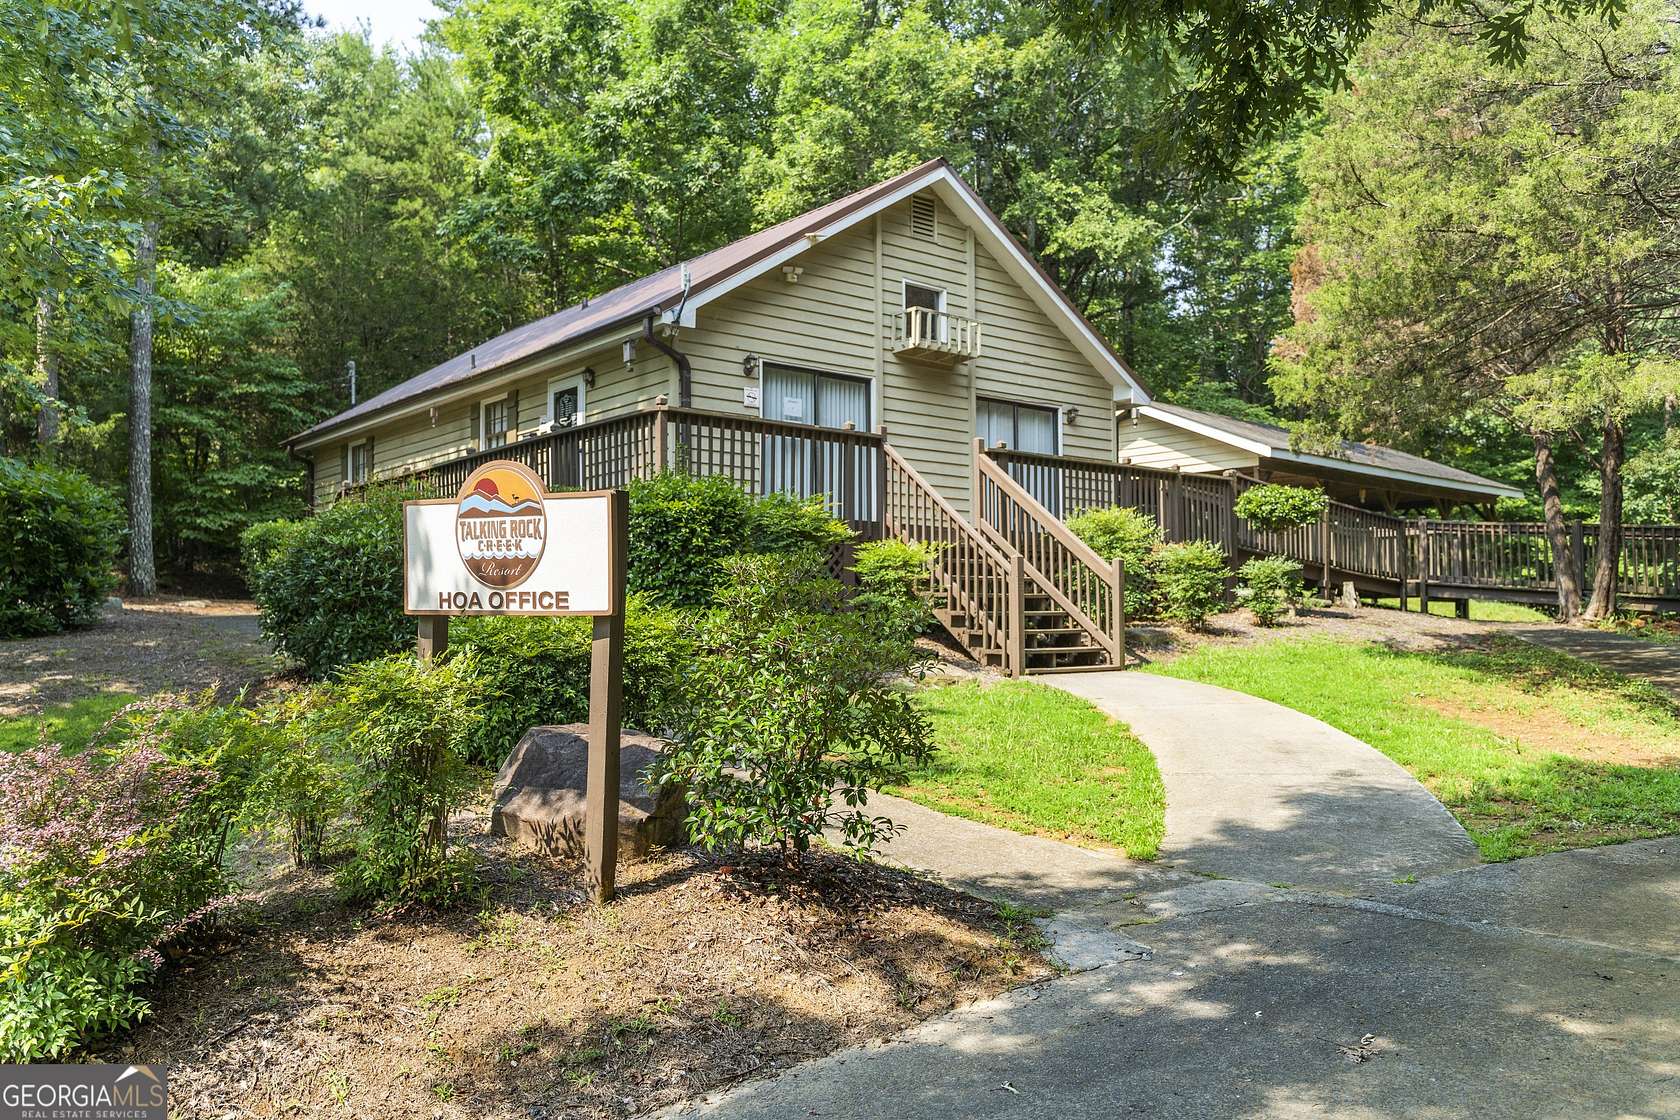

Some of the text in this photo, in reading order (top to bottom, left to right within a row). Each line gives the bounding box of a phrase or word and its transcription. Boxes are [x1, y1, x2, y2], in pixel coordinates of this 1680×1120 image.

[460, 518, 542, 541] TALKING ROCK
[479, 561, 522, 576] Resort
[439, 591, 570, 609] HOA OFFICE
